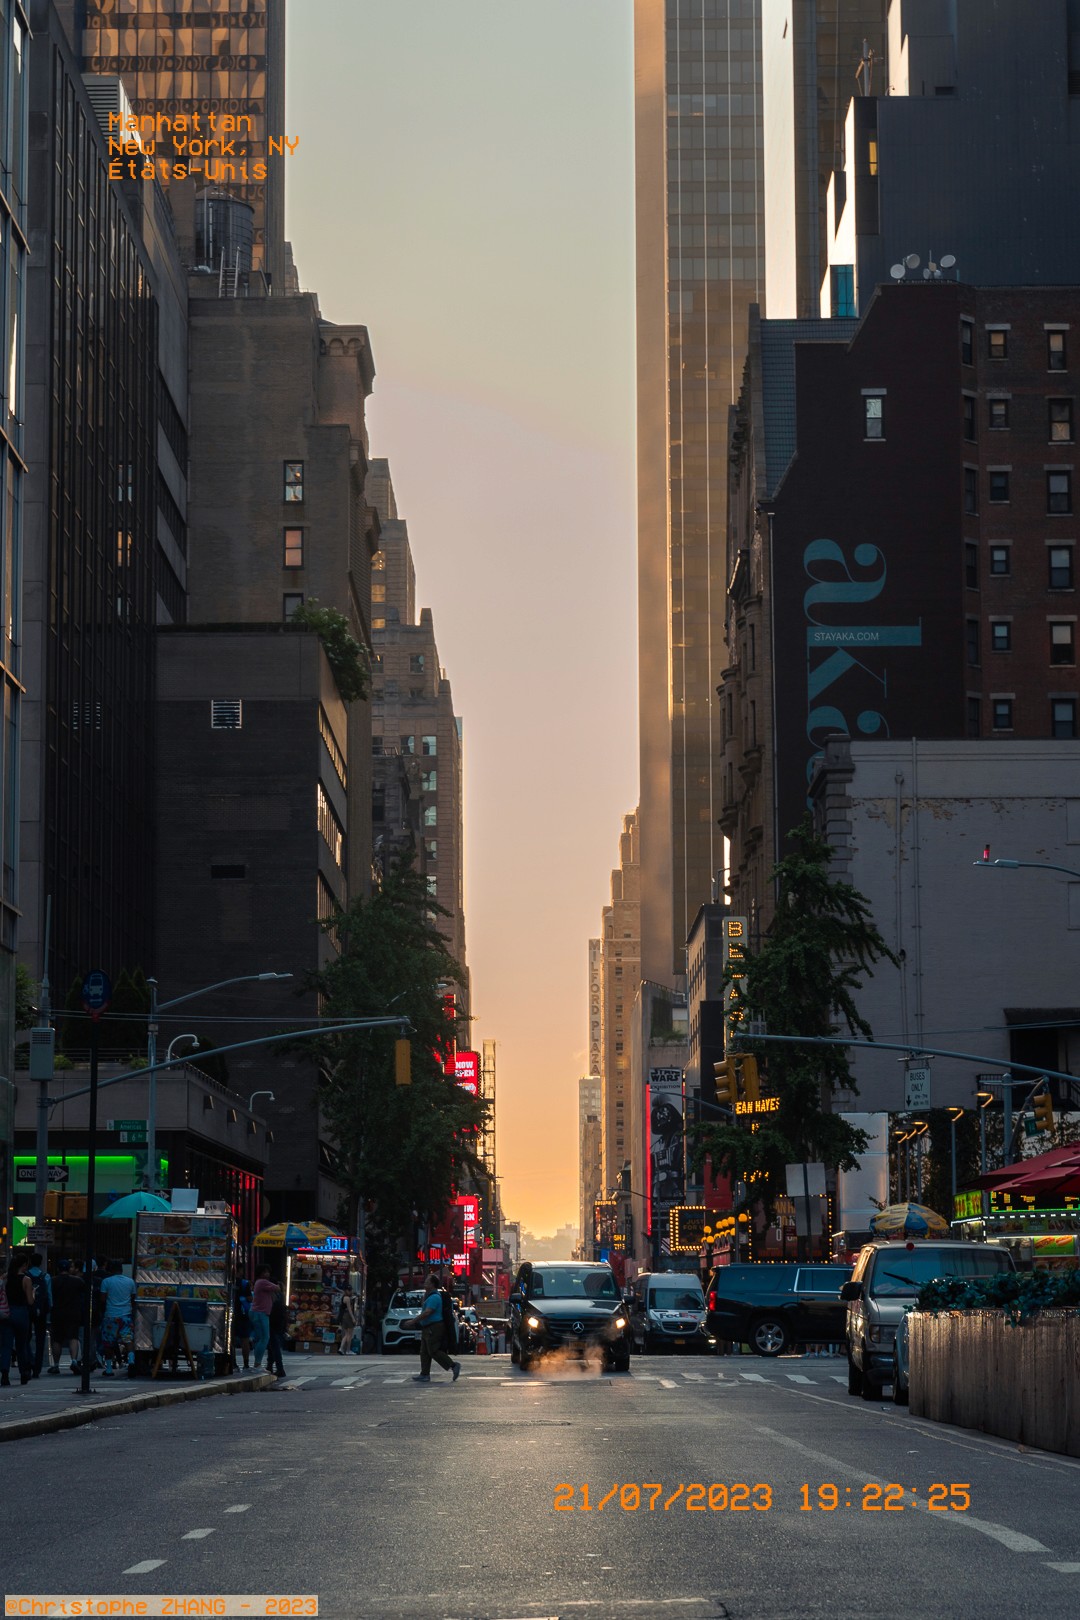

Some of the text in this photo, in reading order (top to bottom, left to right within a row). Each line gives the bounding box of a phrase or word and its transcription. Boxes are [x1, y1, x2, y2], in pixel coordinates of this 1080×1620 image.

[814, 632, 880, 642] STAYAKA.COM
[590, 939, 600, 1076] MILFORD PLAZA
[910, 1072, 925, 1081] BUSES
[911, 1083, 923, 1091] ONLY
[735, 1101, 753, 1115] EAN
[20, 1170, 37, 1178] ONE
